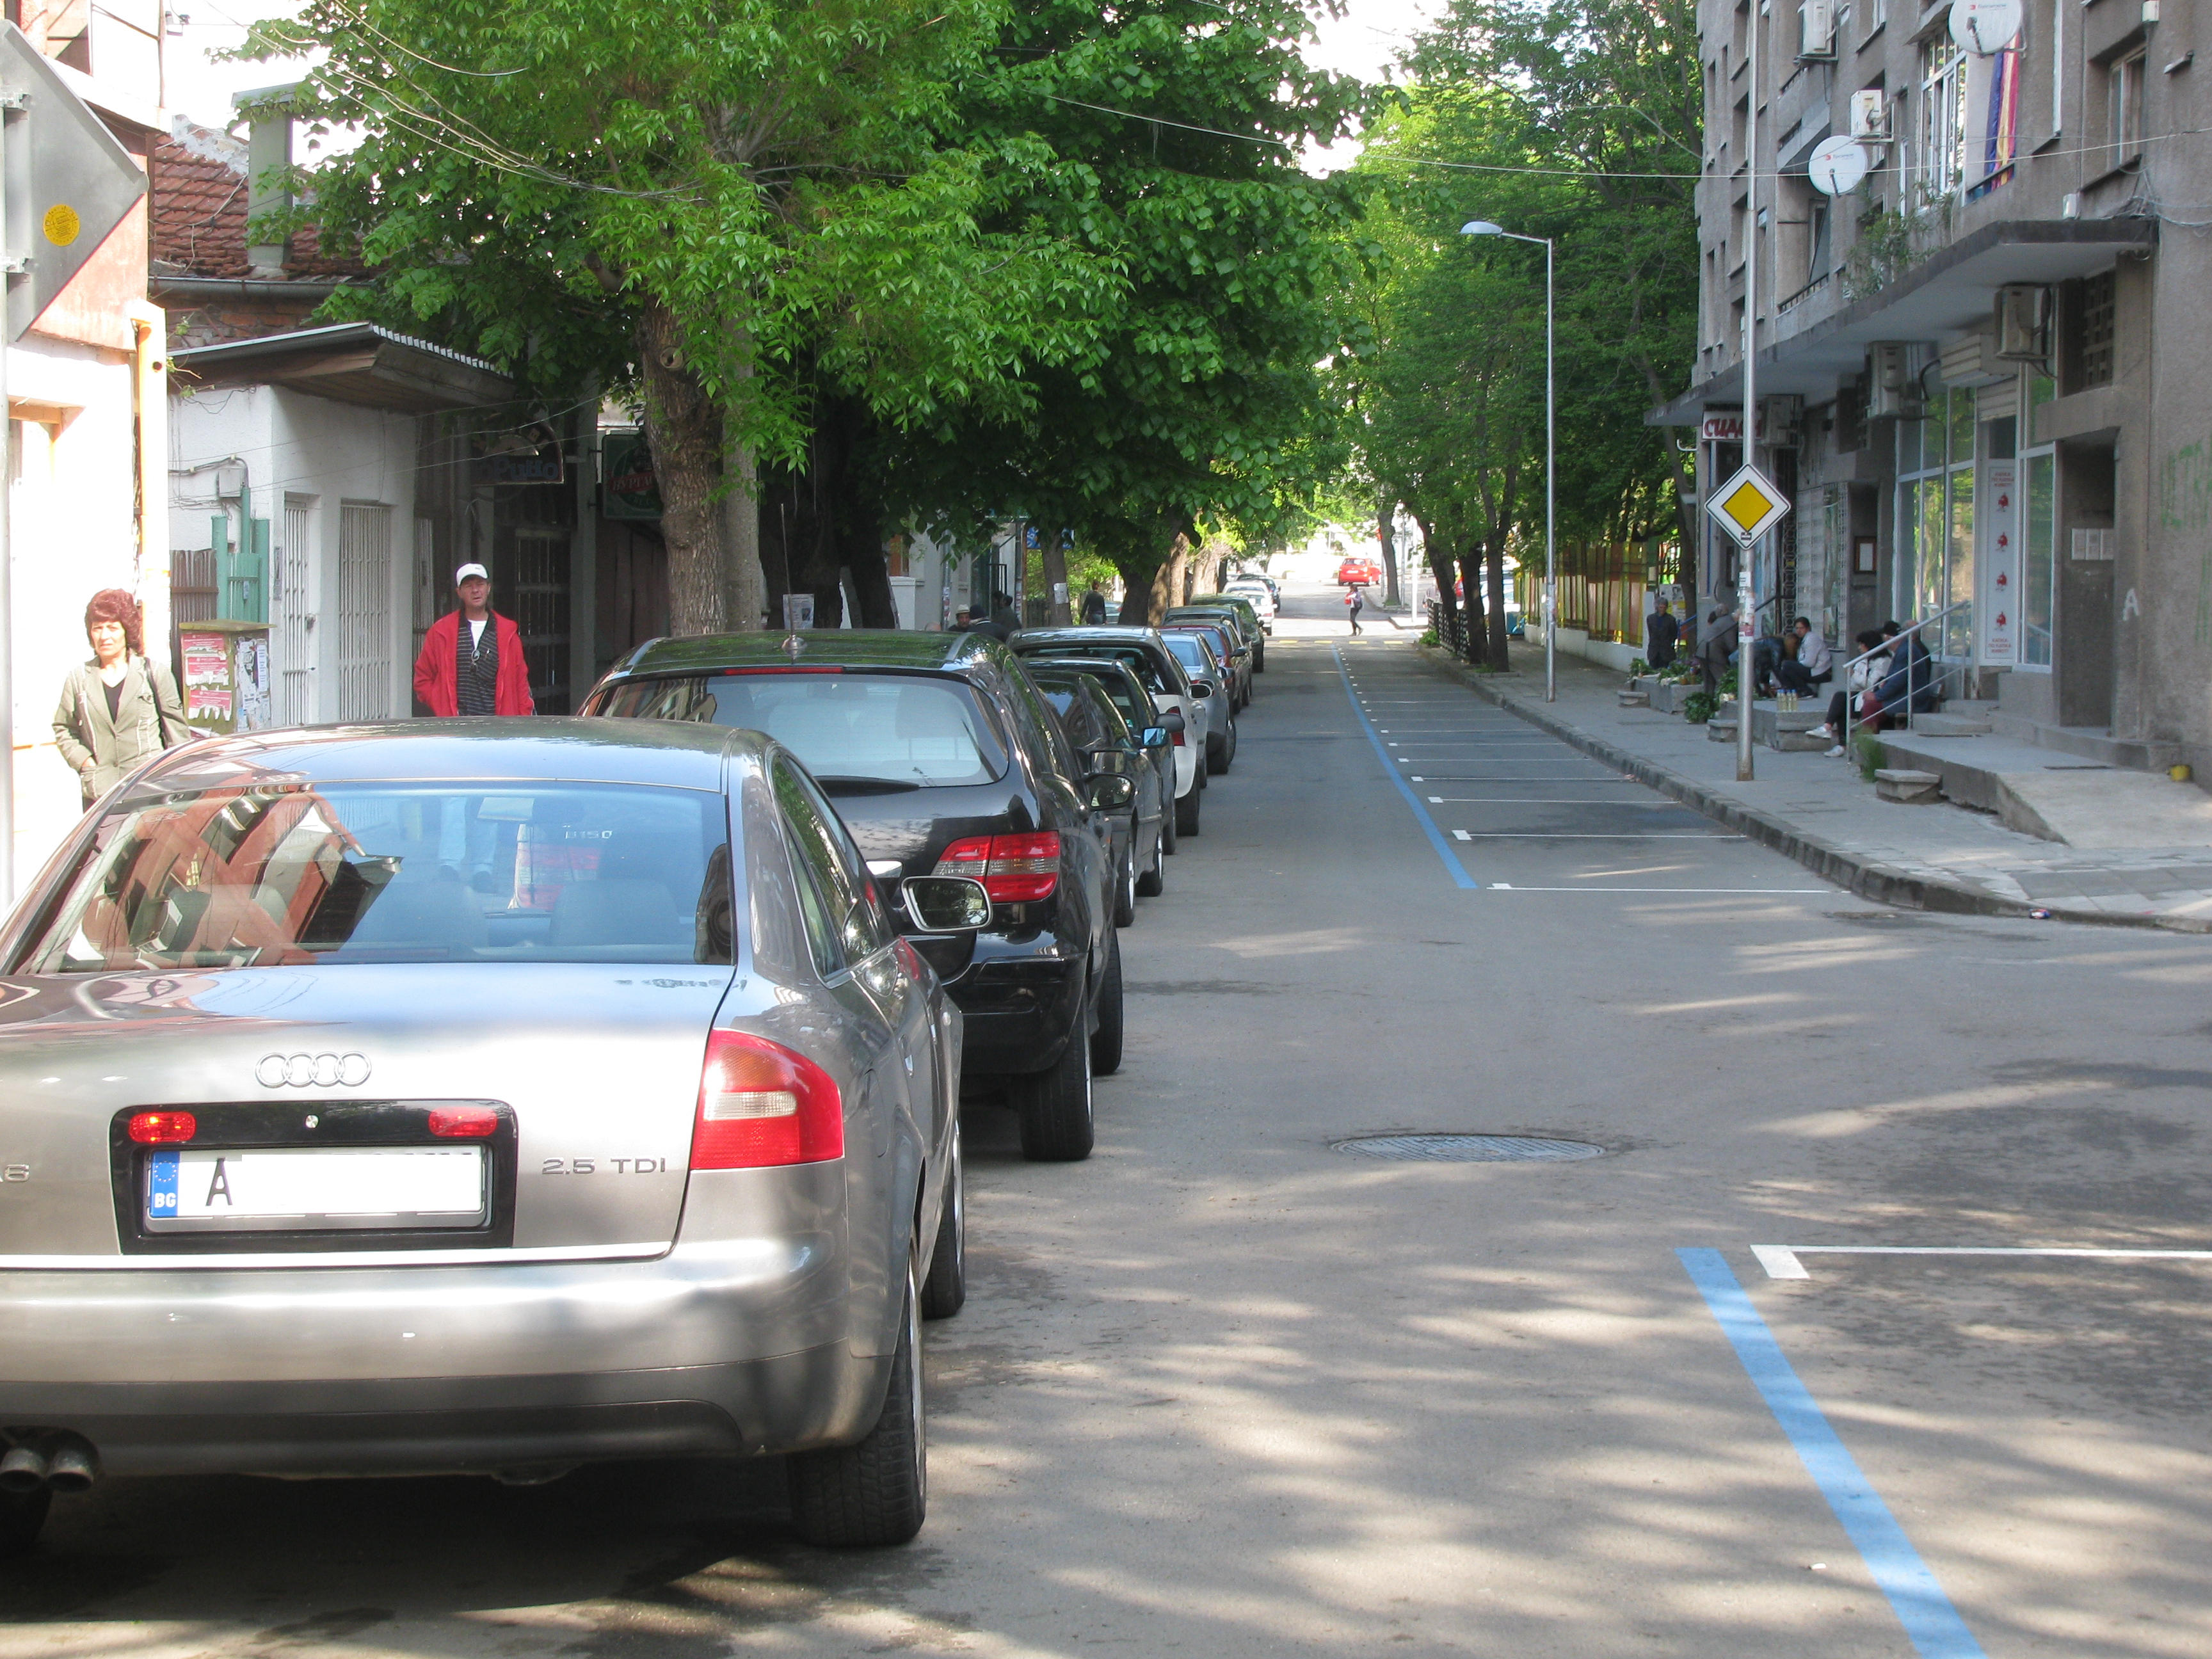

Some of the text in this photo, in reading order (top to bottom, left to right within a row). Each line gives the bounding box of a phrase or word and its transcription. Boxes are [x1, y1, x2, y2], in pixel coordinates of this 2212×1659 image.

[542, 1157, 666, 1174] 2.5 TDI
[154, 1192, 176, 1208] BG
